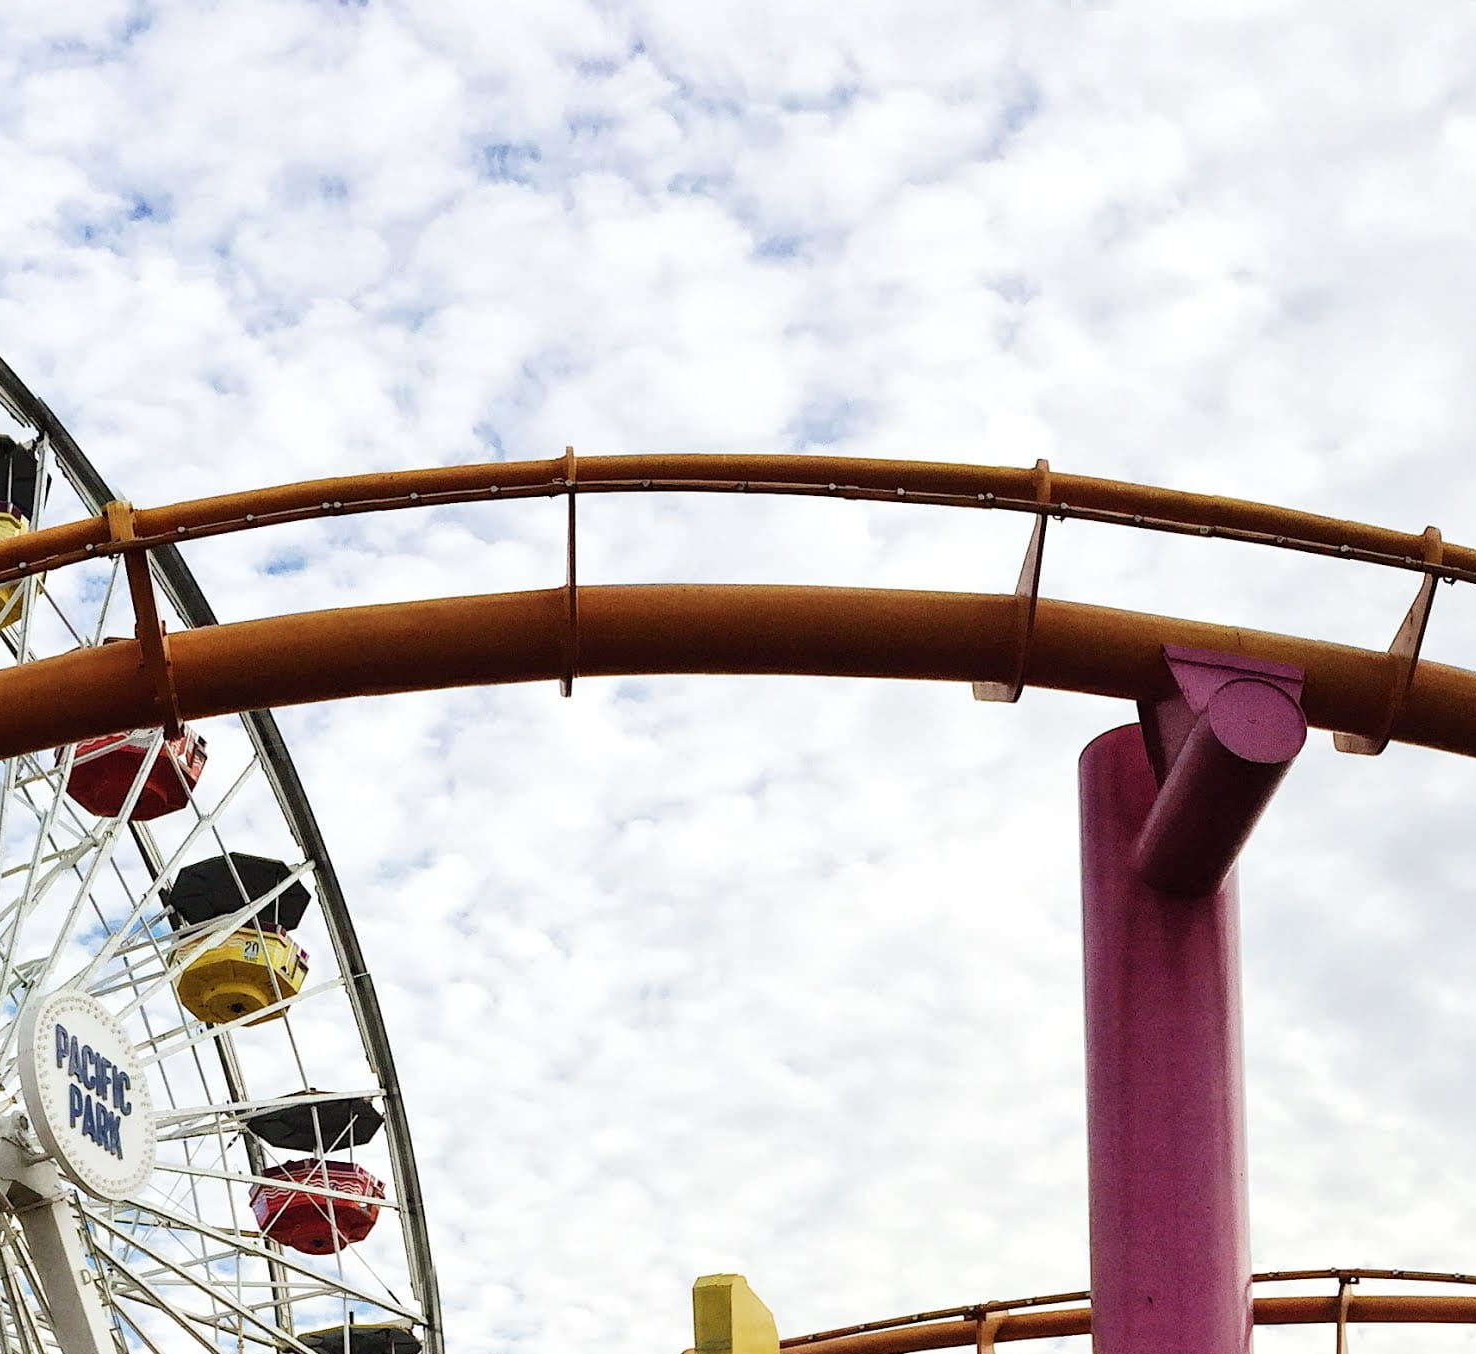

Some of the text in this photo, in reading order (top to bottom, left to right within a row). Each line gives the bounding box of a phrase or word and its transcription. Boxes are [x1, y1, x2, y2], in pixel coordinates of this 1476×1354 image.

[244, 941, 260, 956] 20
[55, 1023, 132, 1117] PACIFIC
[69, 1083, 124, 1161] PARK
